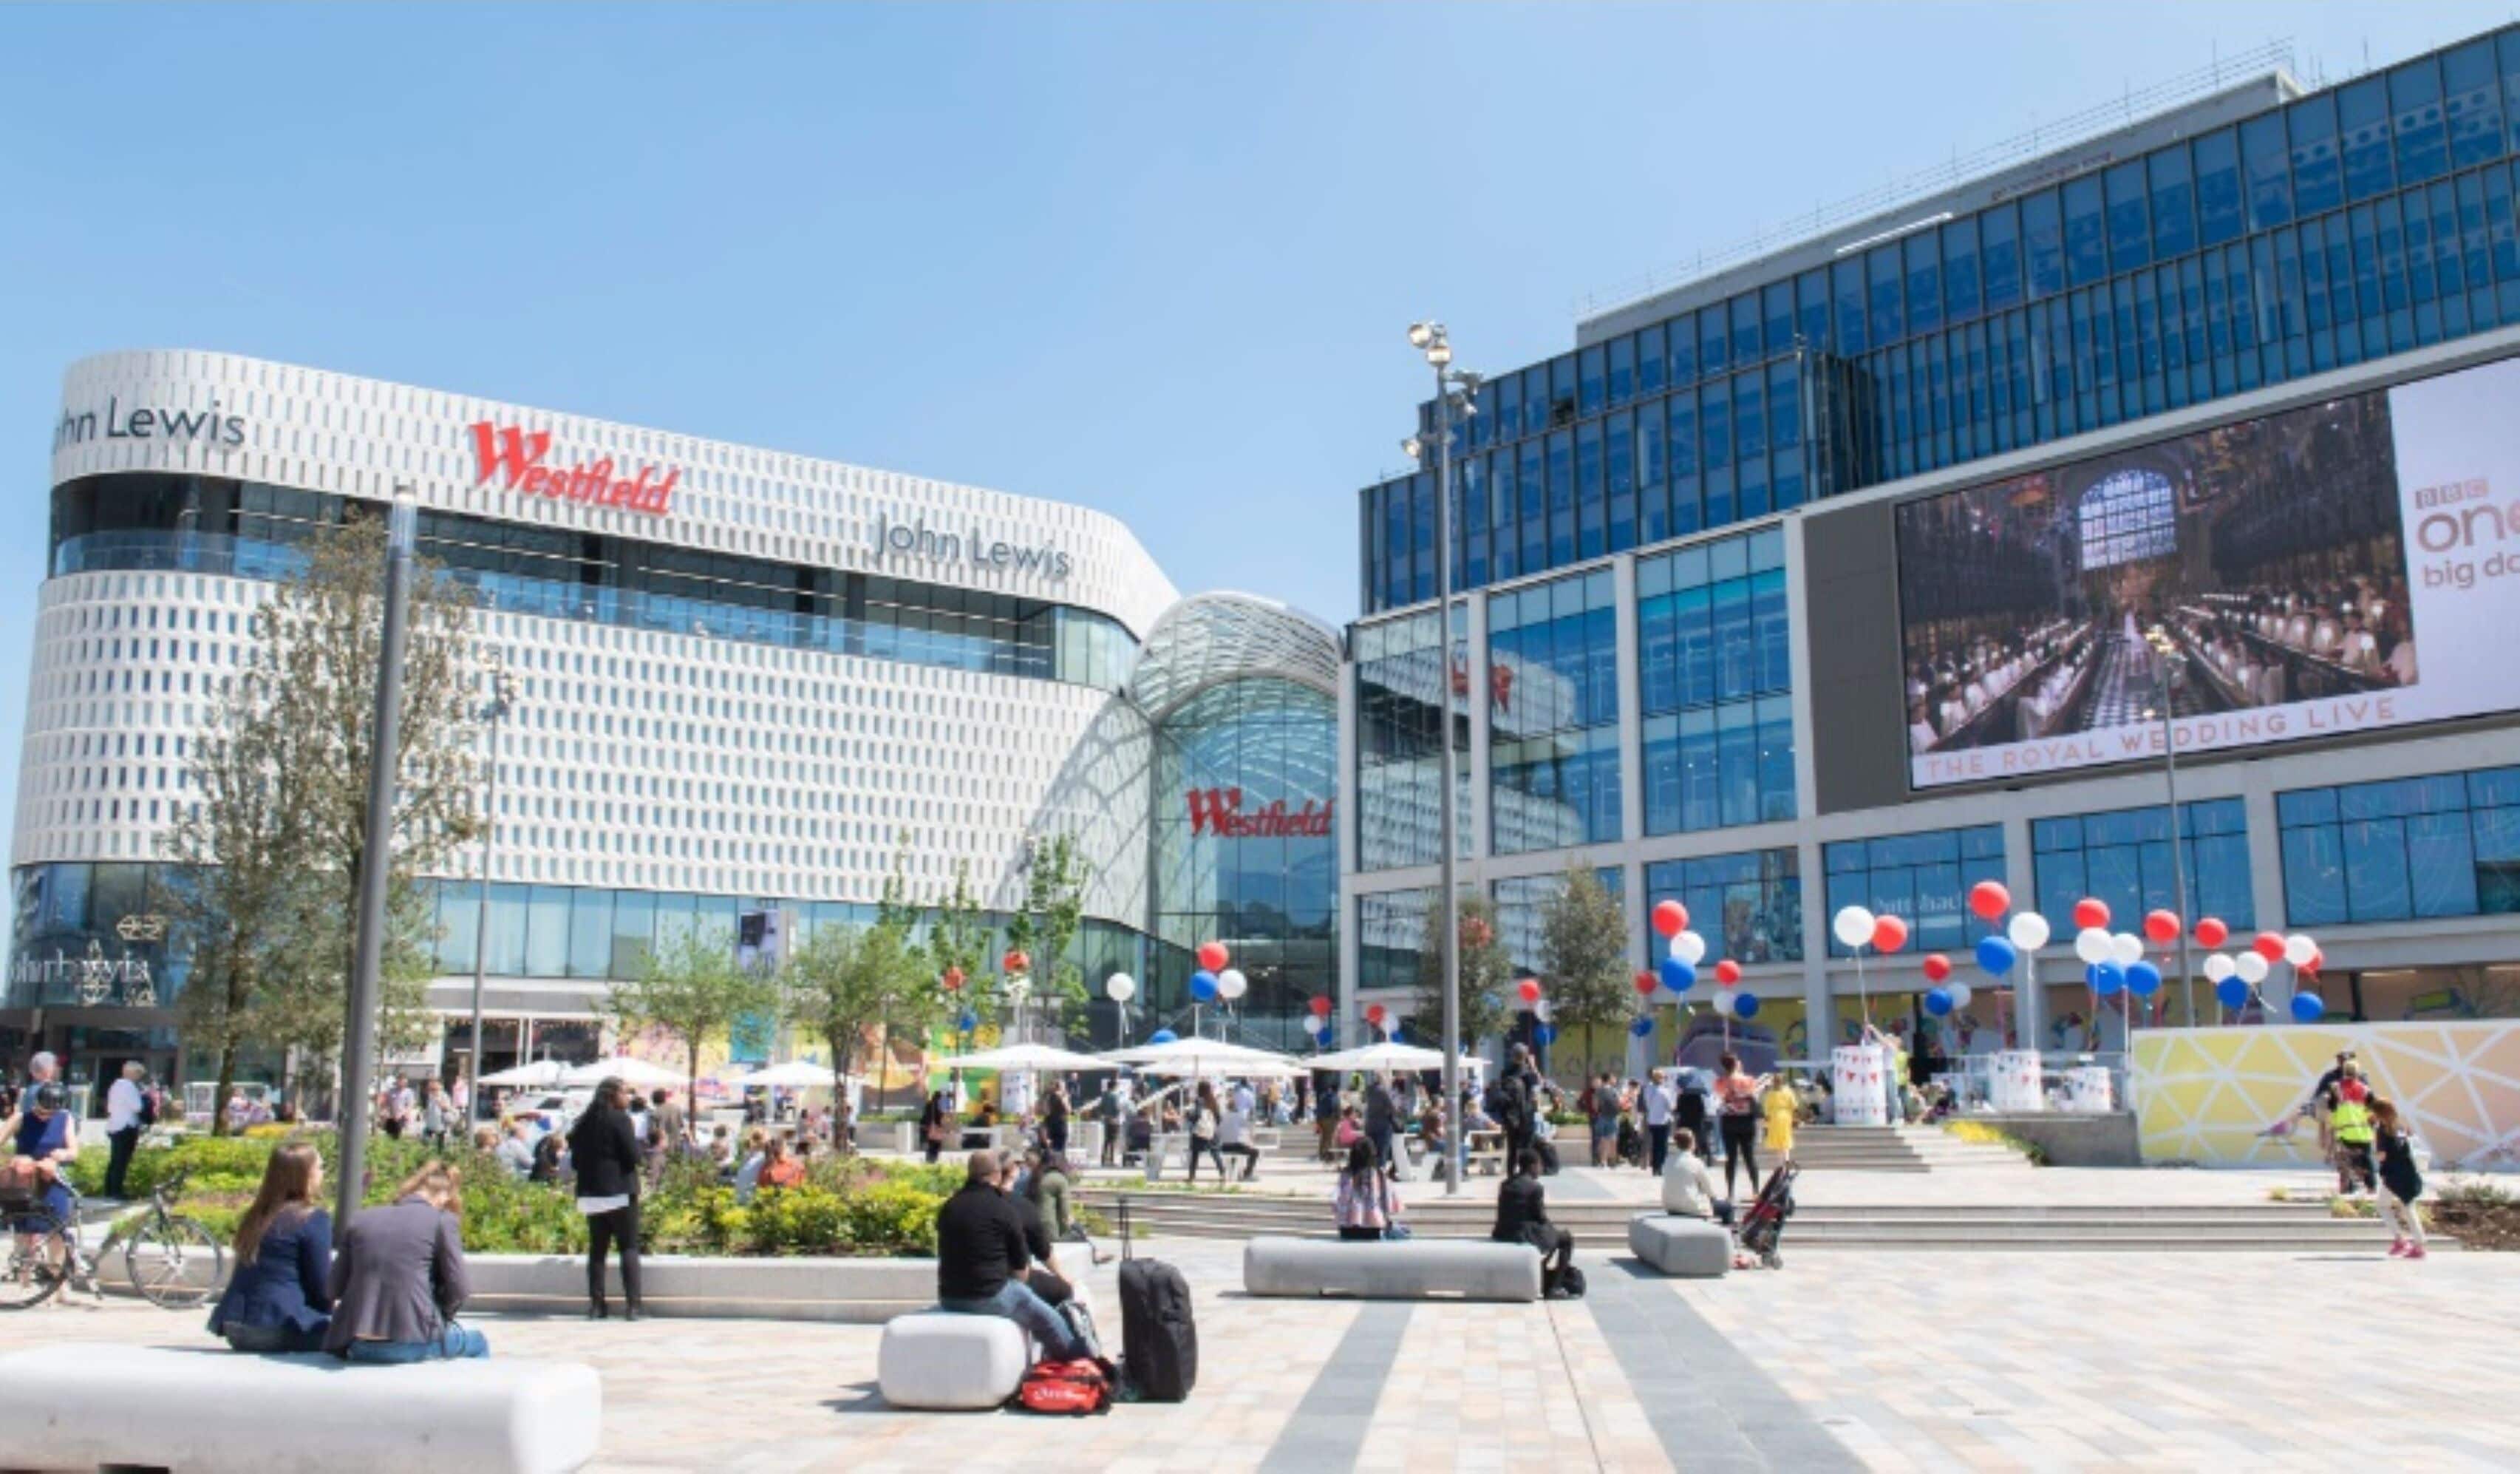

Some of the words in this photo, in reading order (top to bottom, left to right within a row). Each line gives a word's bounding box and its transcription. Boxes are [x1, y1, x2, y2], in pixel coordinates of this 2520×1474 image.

[106, 395, 245, 444] Lewis
[469, 421, 681, 515] Westfield
[874, 512, 959, 560] John
[972, 526, 1069, 575] Lewis
[2424, 560, 2475, 590] big
[1926, 754, 1983, 778] THE
[2003, 740, 2103, 770] ROYAL
[2120, 713, 2288, 753] WEDDING
[2309, 696, 2395, 728] LIVE
[1185, 787, 1336, 838] Westfield
